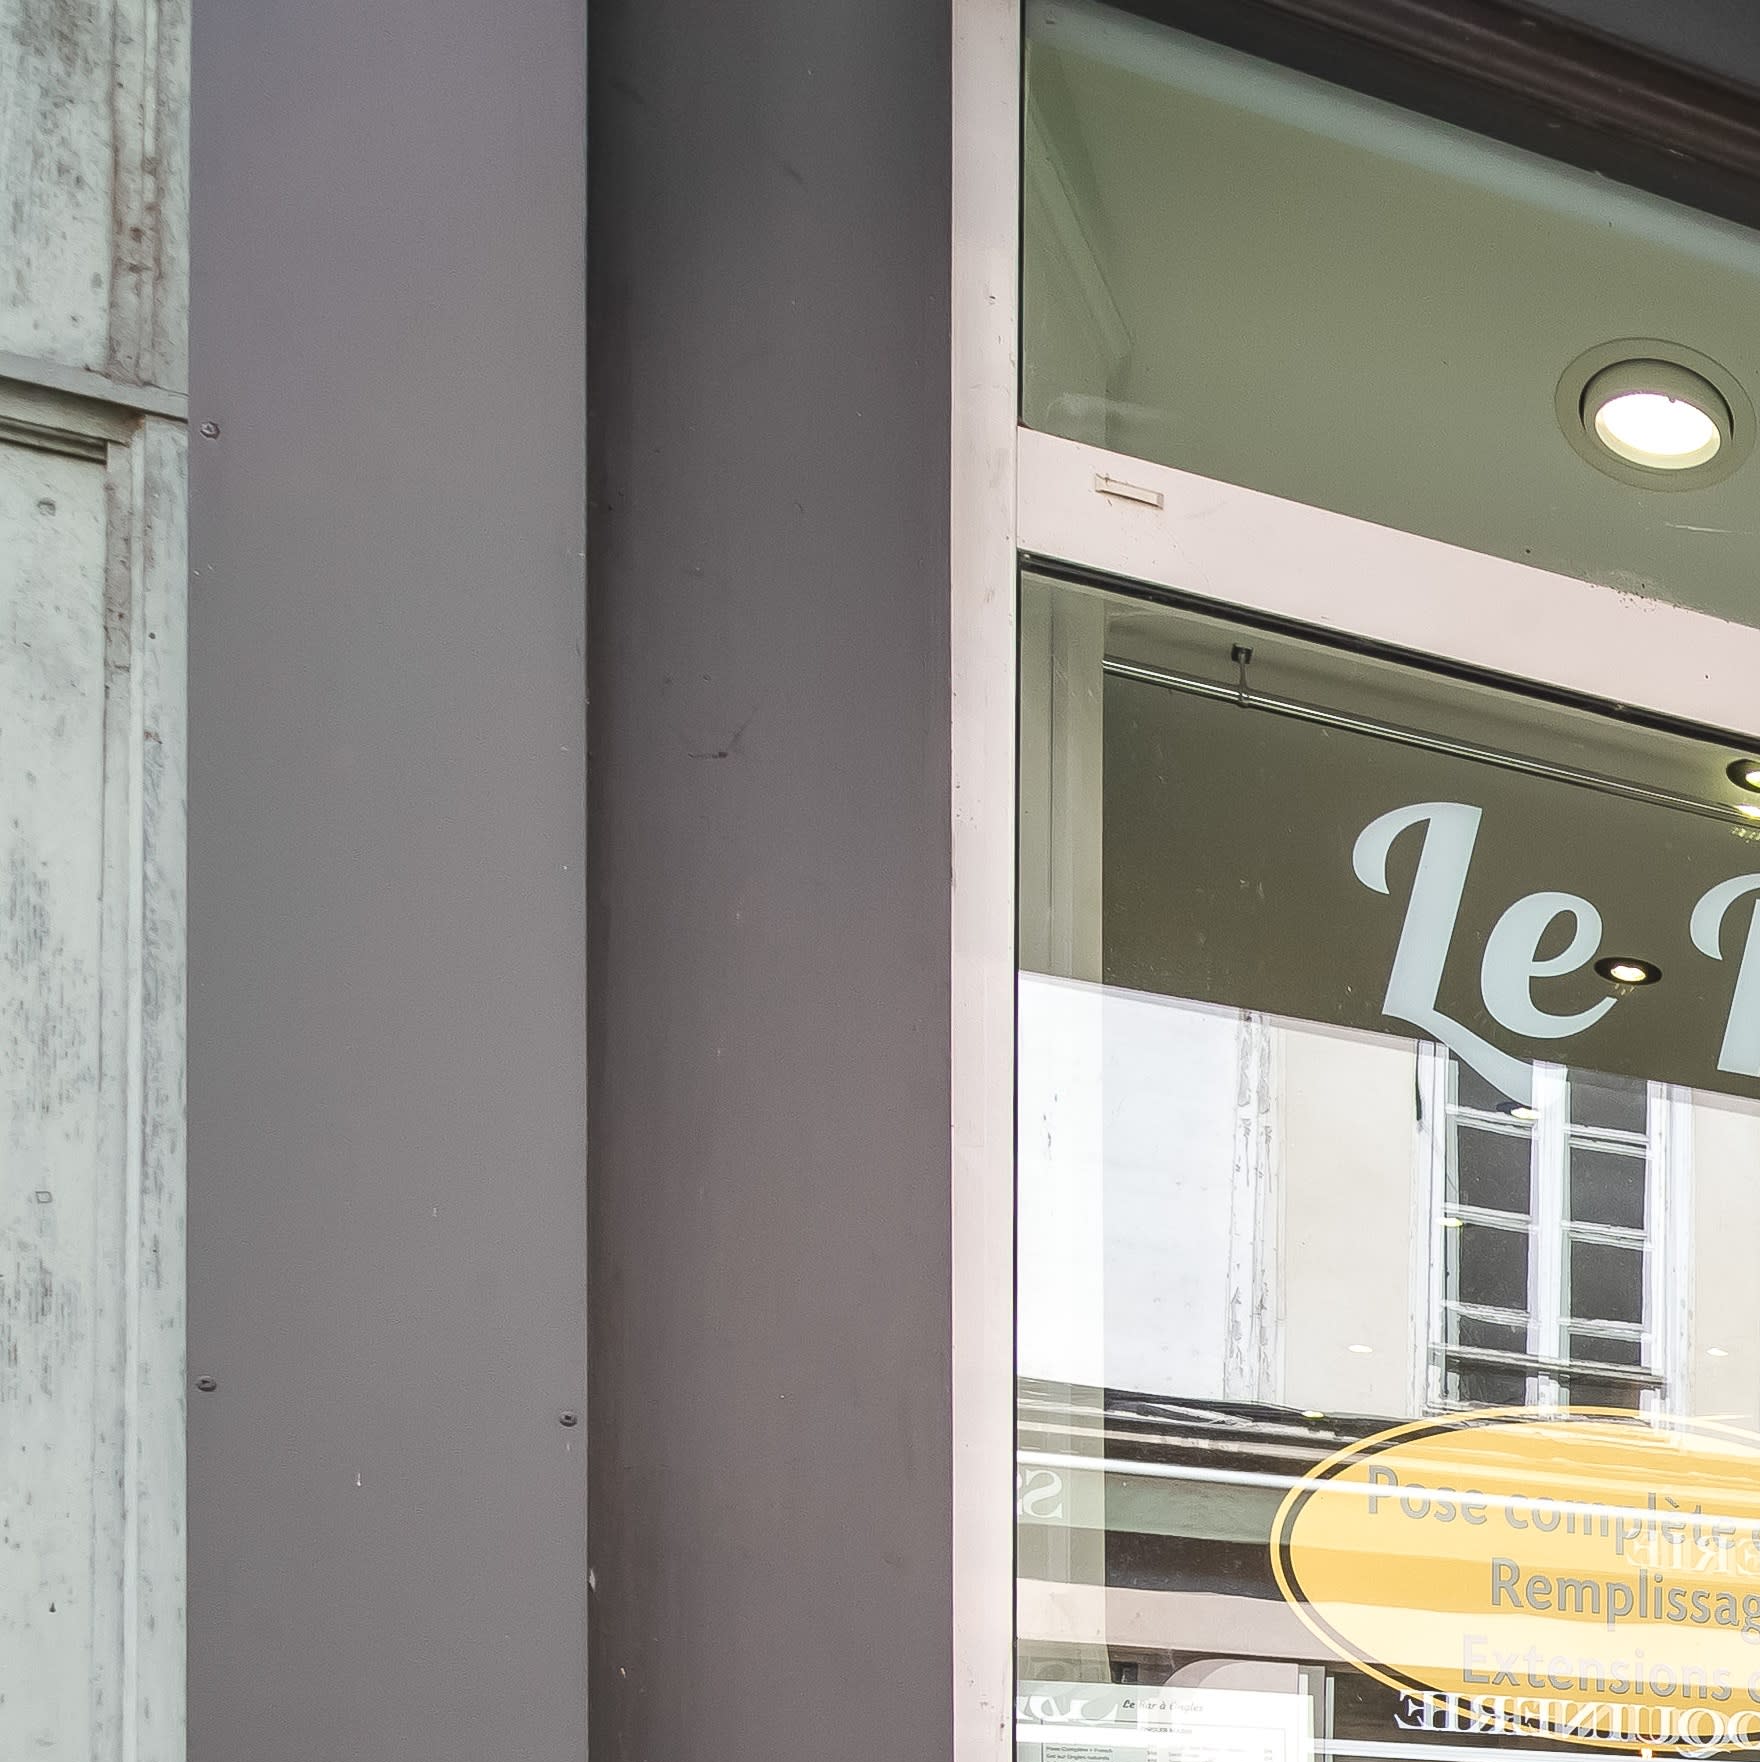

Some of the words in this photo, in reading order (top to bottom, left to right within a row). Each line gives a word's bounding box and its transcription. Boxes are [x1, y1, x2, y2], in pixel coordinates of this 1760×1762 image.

[1352, 801, 1618, 1108] Le
[1366, 1464, 1487, 1527] Pose
[1502, 1490, 1738, 1562] complète
[1461, 1634, 1734, 1704] Extensions
